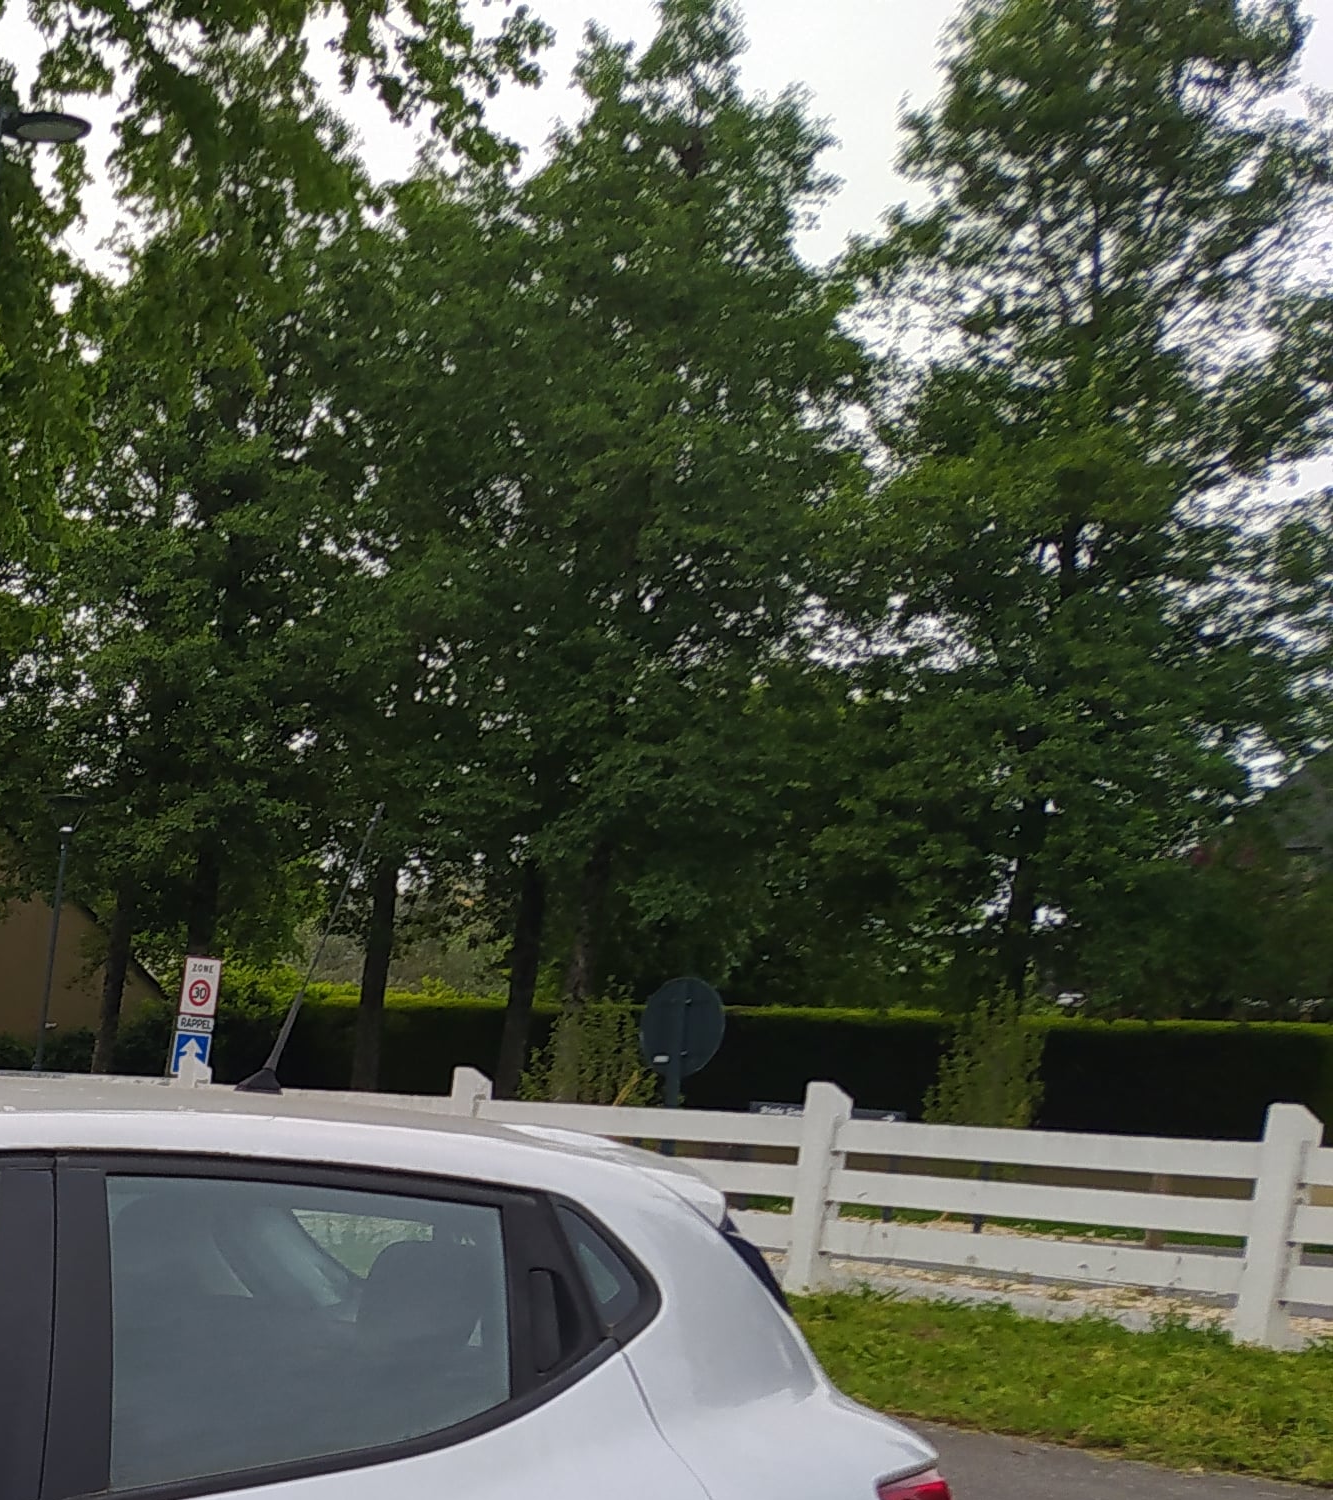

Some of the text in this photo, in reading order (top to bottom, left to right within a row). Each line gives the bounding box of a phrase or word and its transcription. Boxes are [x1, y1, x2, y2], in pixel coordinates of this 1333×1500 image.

[192, 964, 214, 974] ZONE
[193, 987, 207, 1000] 30
[180, 1017, 211, 1030] RAPPEL
